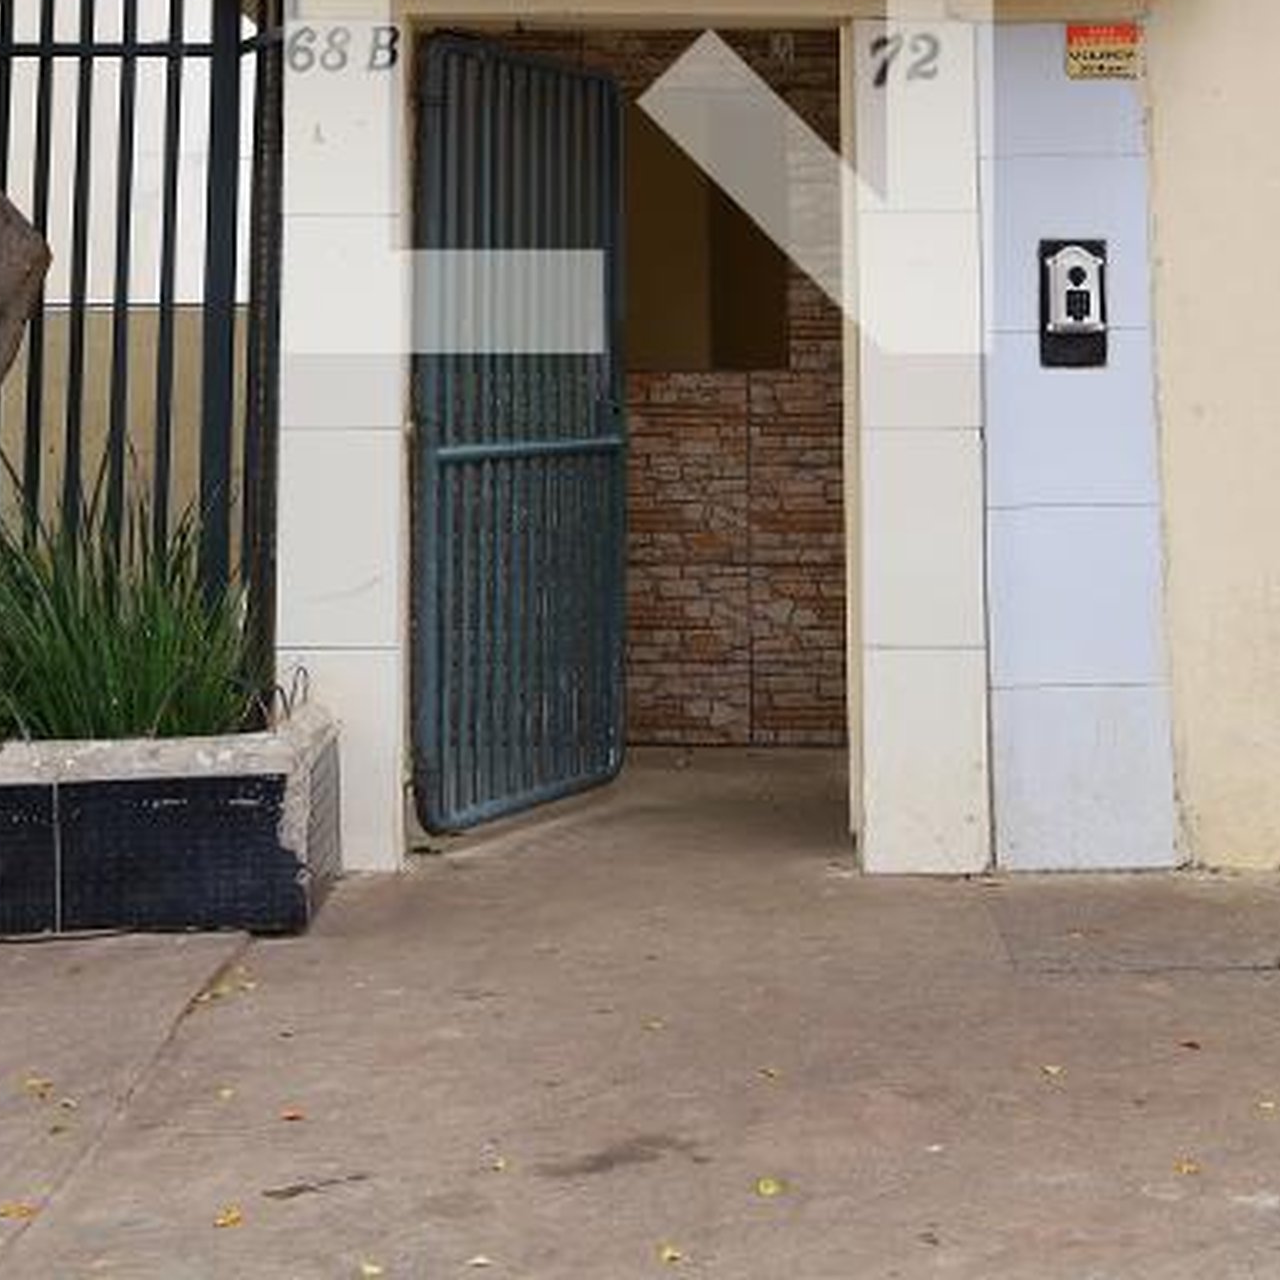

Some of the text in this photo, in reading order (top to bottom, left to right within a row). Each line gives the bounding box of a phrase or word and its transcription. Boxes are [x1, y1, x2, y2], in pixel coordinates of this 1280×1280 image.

[287, 25, 400, 73] 68 B
[869, 33, 940, 88] 72
